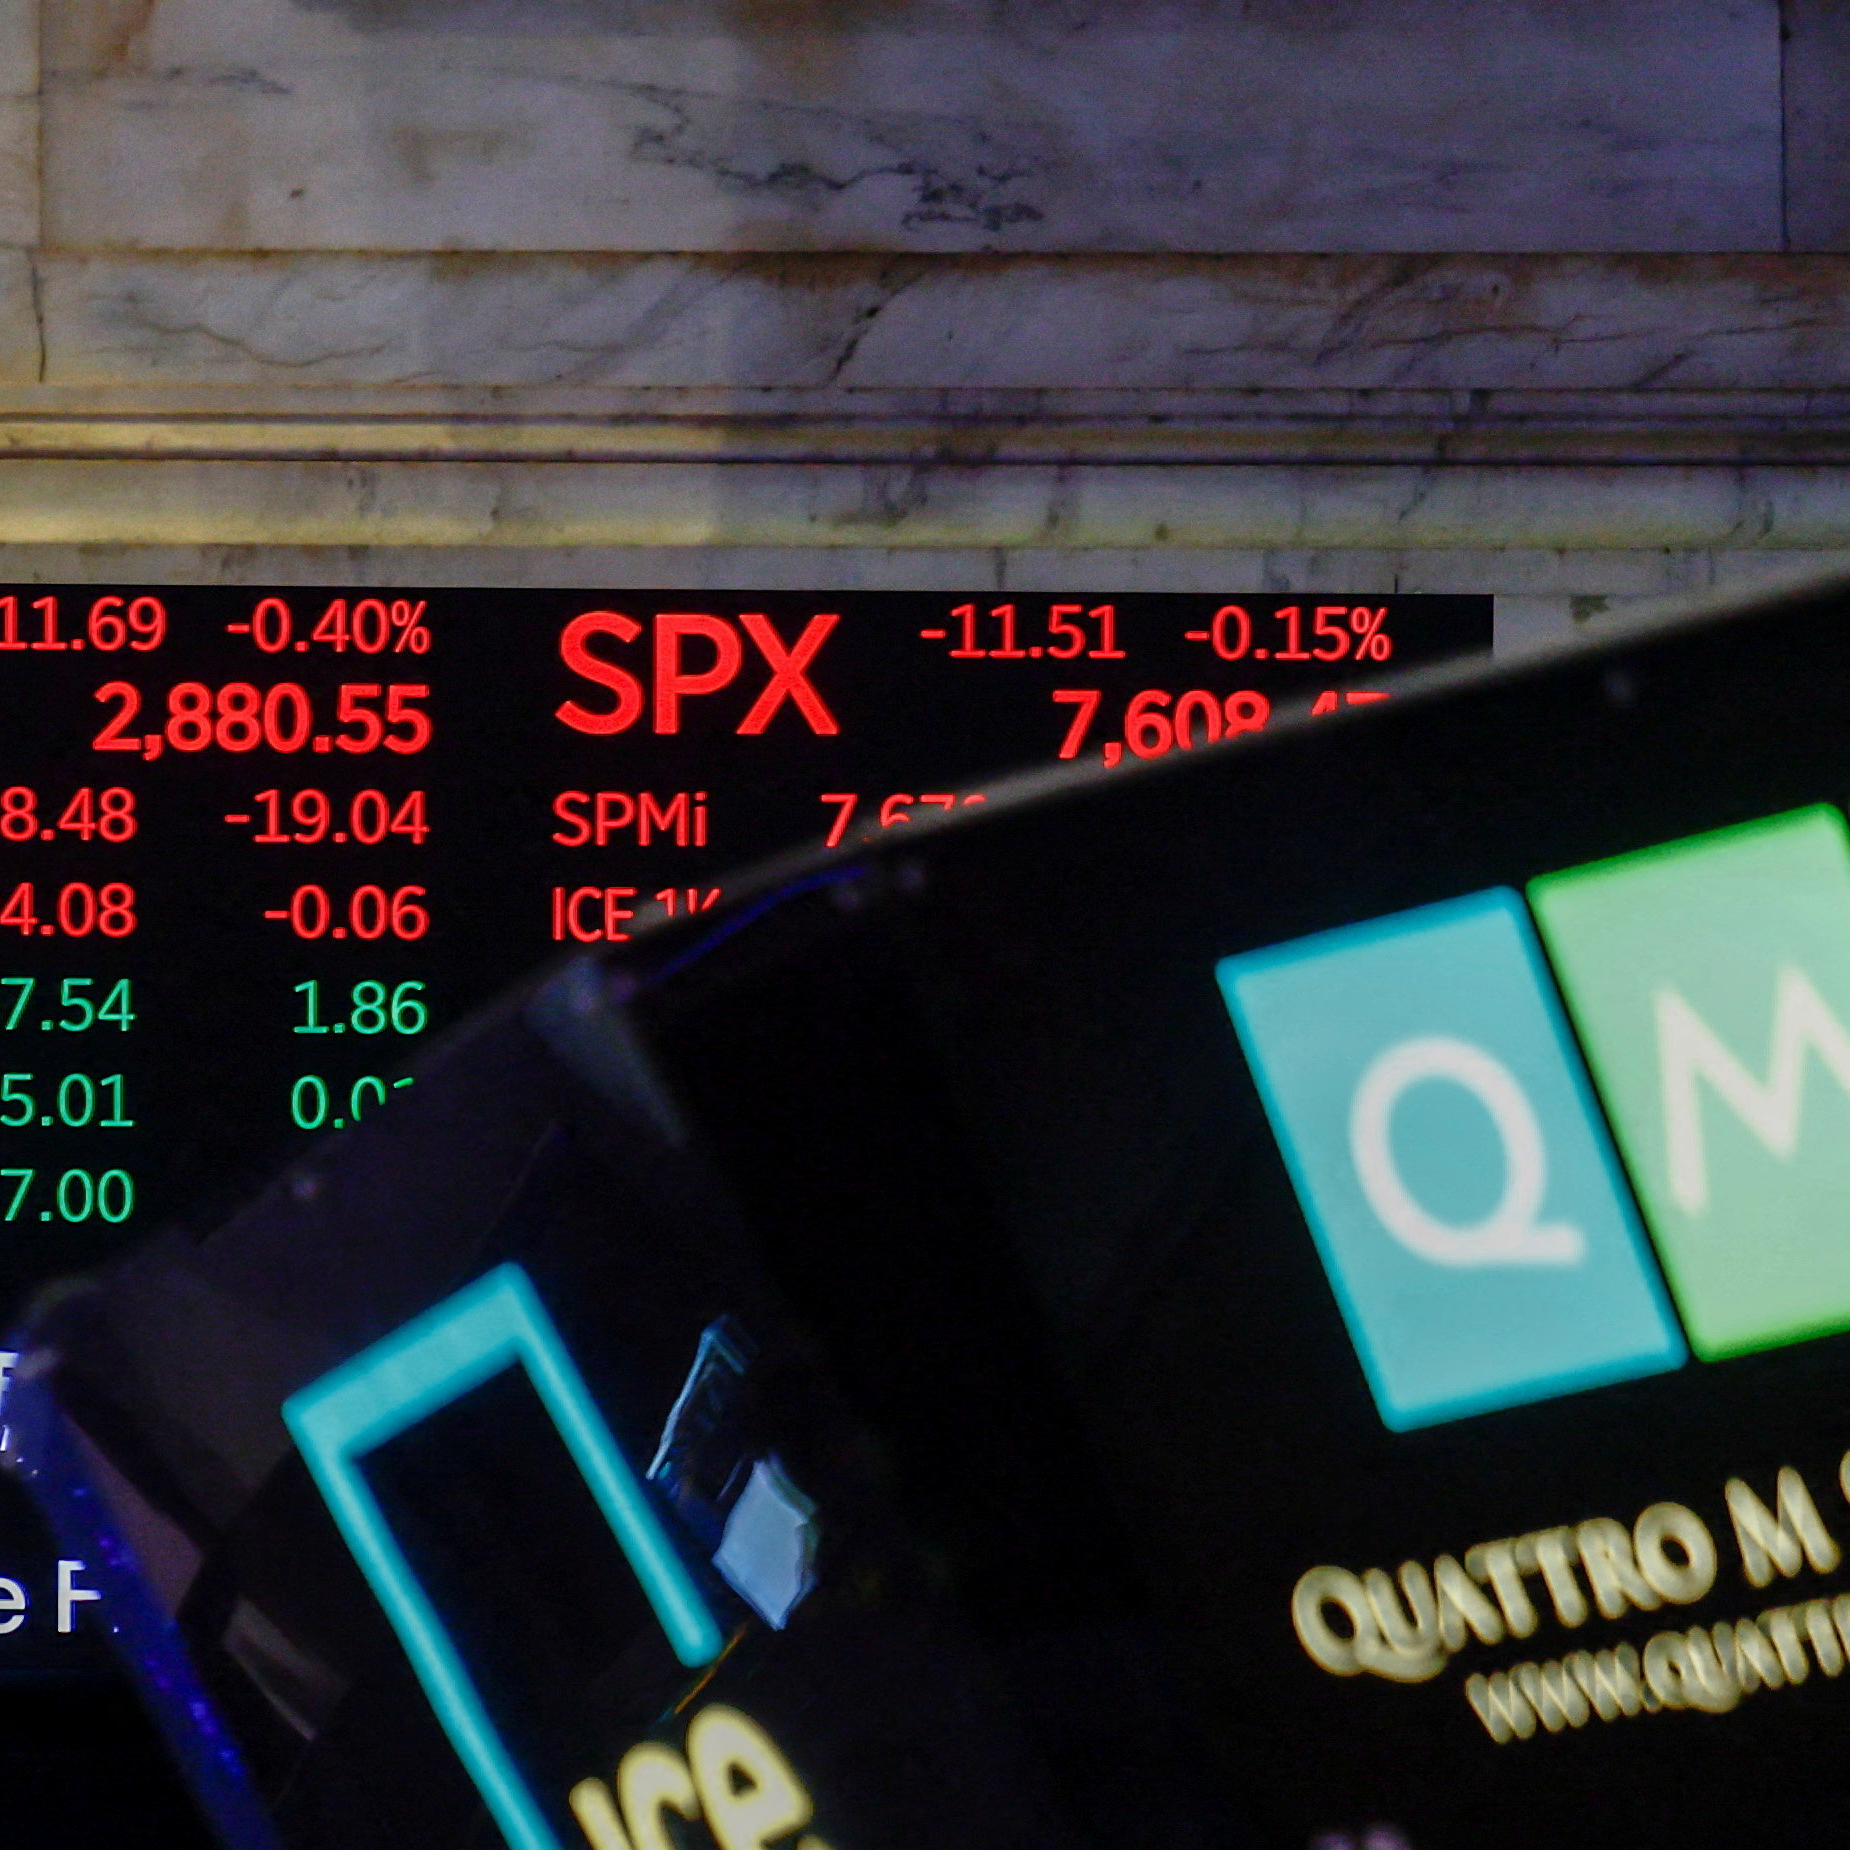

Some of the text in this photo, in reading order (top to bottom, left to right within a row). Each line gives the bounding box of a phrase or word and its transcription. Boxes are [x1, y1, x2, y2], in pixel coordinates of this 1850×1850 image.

[226, 597, 431, 654] -0.40%
[920, 603, 1392, 661] -11.51 -0.15%
[555, 611, 840, 736] SPX
[92, 681, 432, 761] 2,880.55
[1053, 690, 1389, 769] 7,608
[225, 789, 430, 844] -19.04
[553, 791, 707, 847] SPMi
[264, 885, 429, 941] -0.06
[553, 887, 636, 942] ICE
[294, 980, 426, 1034] 1.86
[0, 1074, 133, 1126] 5.01
[292, 1075, 413, 1129] 0.0
[1350, 1036, 1586, 1267] Q
[1292, 1466, 1840, 1683] QUATTRO M
[1465, 1596, 1850, 1744] WWW.QUATT
